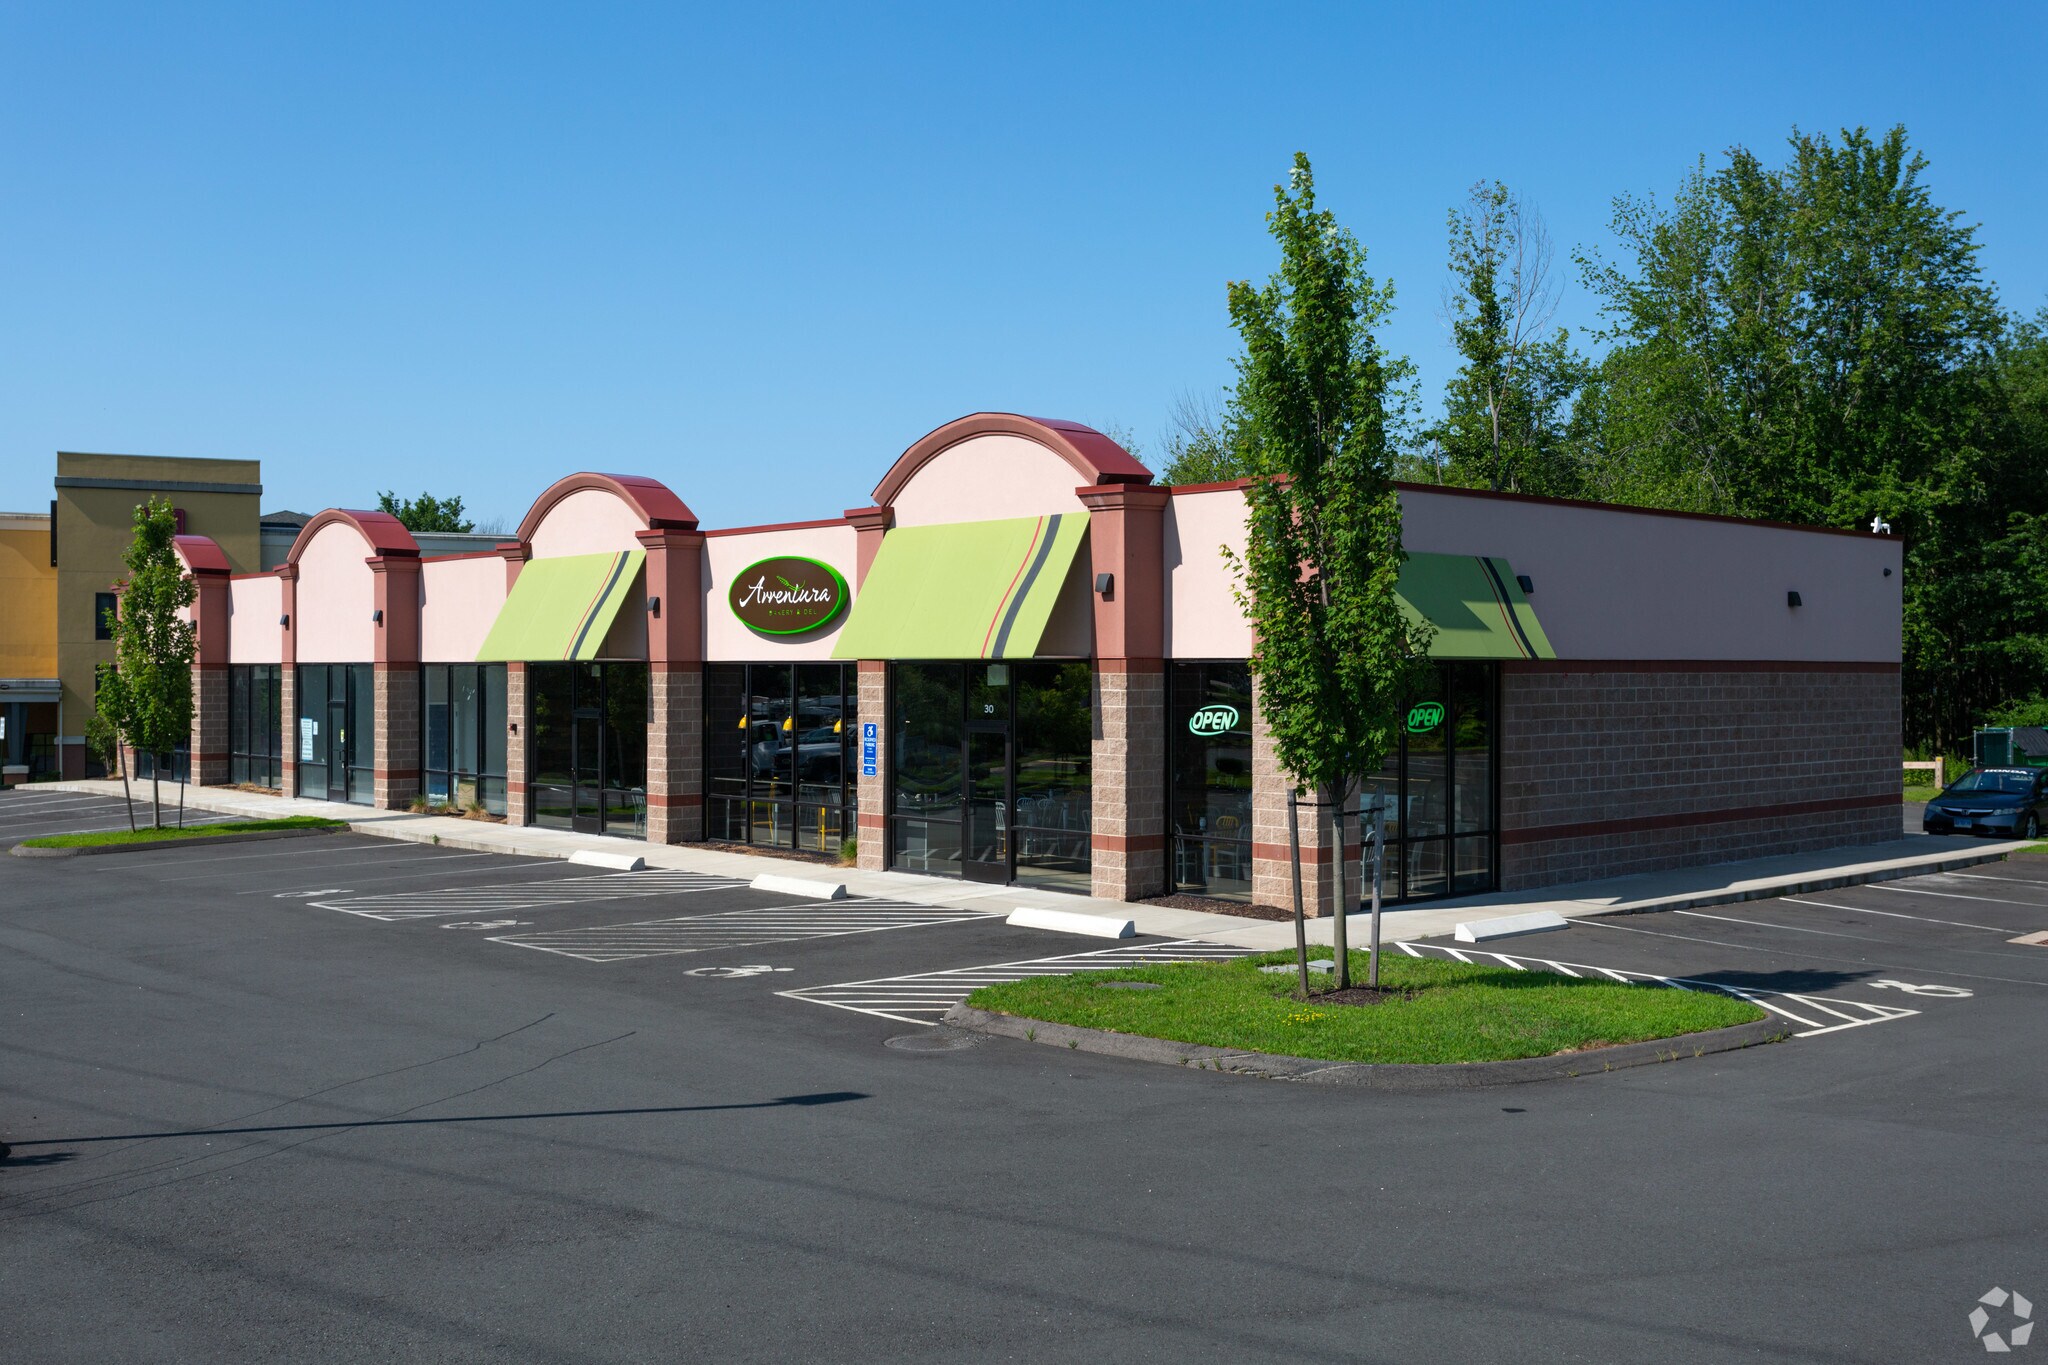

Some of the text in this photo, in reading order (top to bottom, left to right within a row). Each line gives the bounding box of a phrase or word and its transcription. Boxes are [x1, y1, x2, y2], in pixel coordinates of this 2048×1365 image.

[739, 575, 832, 608] Avventura
[984, 704, 994, 713] 30
[1408, 708, 1441, 727] OPEN
[1192, 711, 1233, 730] OPEN
